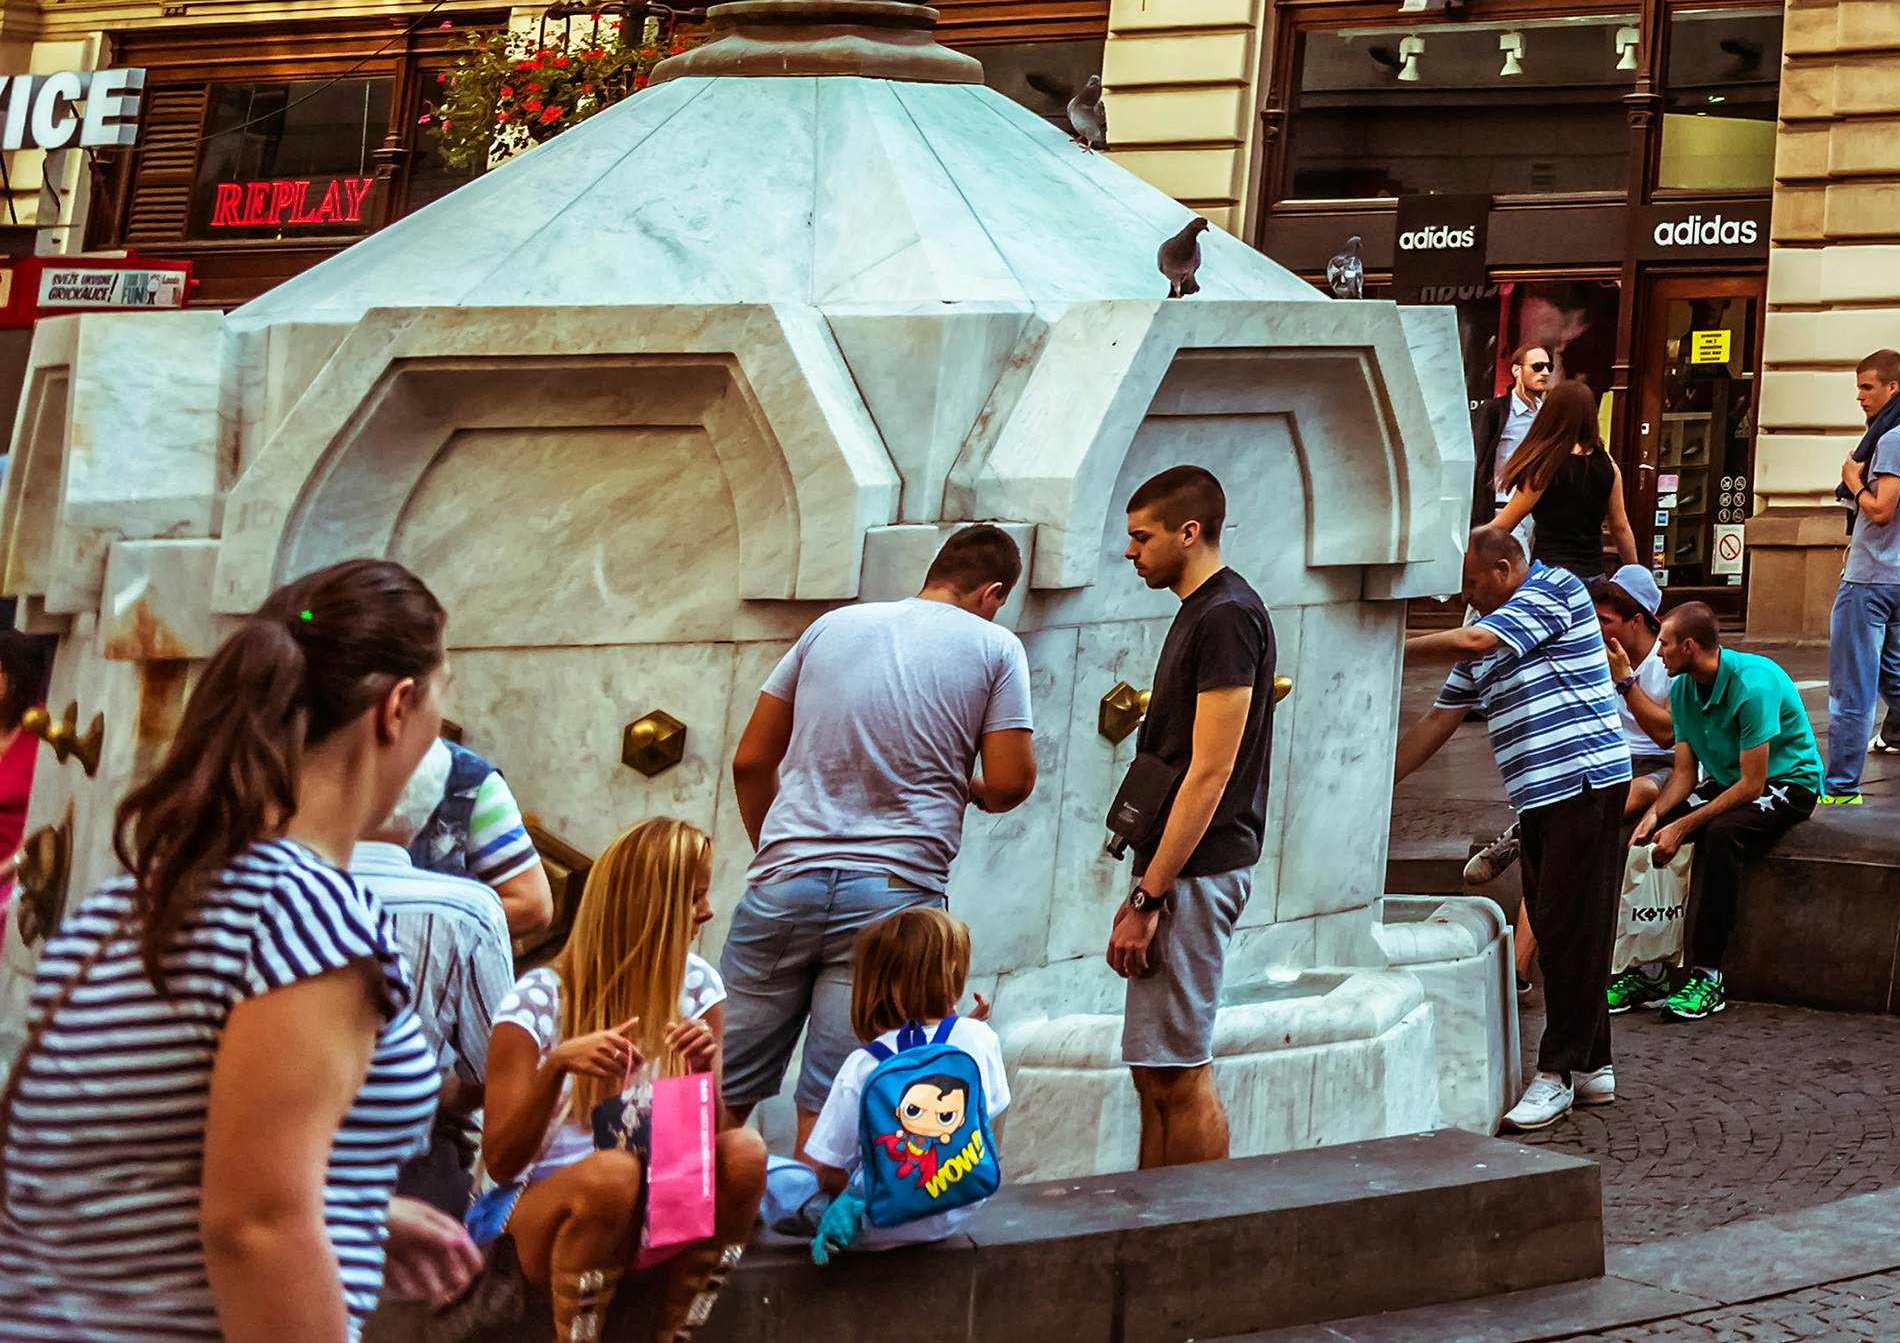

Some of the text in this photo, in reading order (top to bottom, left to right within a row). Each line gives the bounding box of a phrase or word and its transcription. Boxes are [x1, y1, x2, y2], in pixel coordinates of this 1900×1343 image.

[0, 68, 146, 150] ICE
[210, 178, 374, 227] REPLAY
[1399, 224, 1475, 251] adidas
[1654, 214, 1758, 246] adidas
[1631, 904, 1684, 922] KOTON
